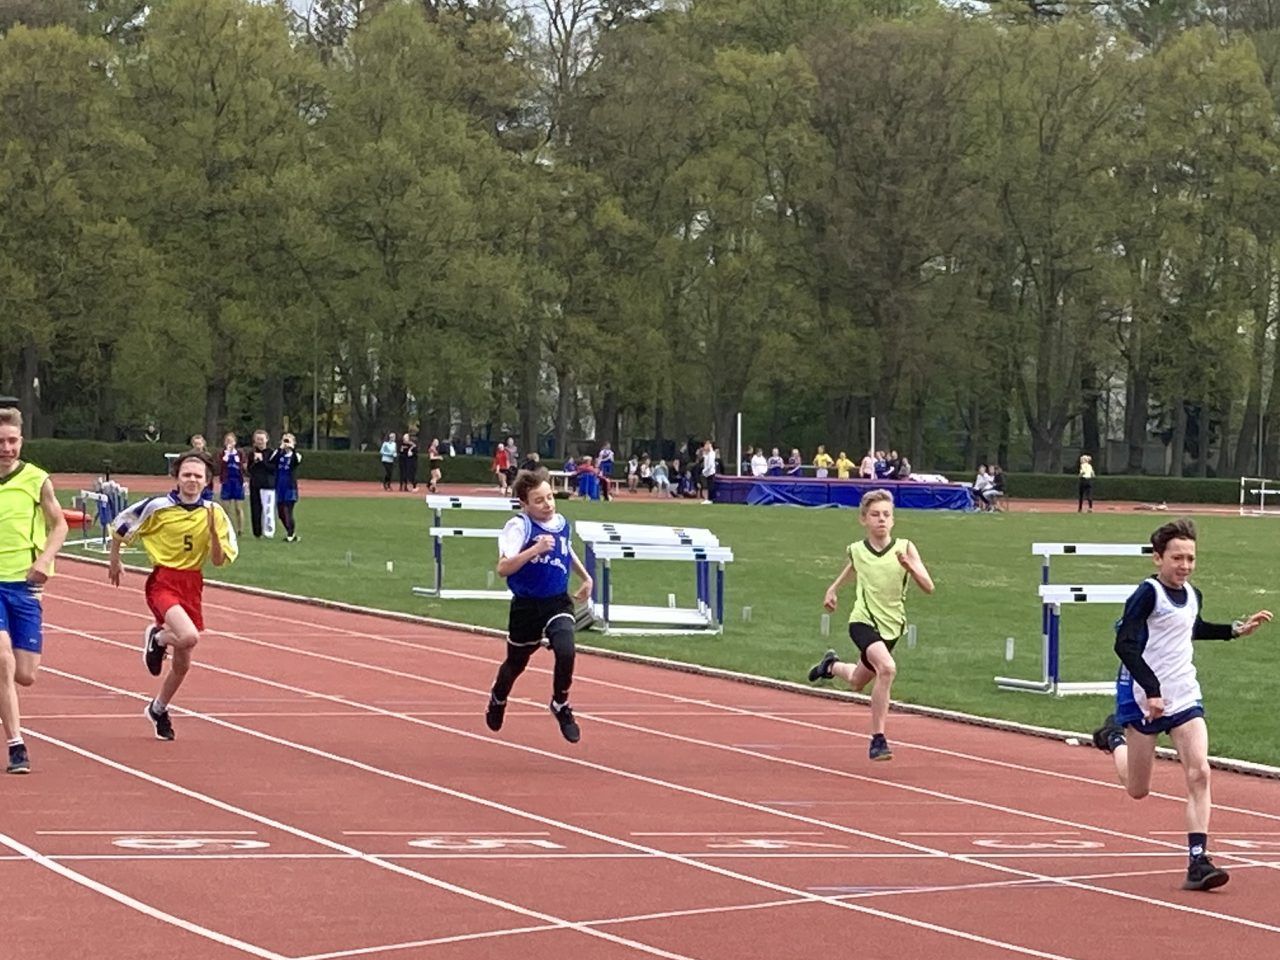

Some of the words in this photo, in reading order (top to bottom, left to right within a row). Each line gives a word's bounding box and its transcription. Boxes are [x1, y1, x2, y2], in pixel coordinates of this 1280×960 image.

[183, 534, 193, 551] 5
[111, 837, 271, 849] 6
[407, 837, 567, 849] 5
[705, 838, 850, 849] 4
[971, 838, 1106, 849] 3
